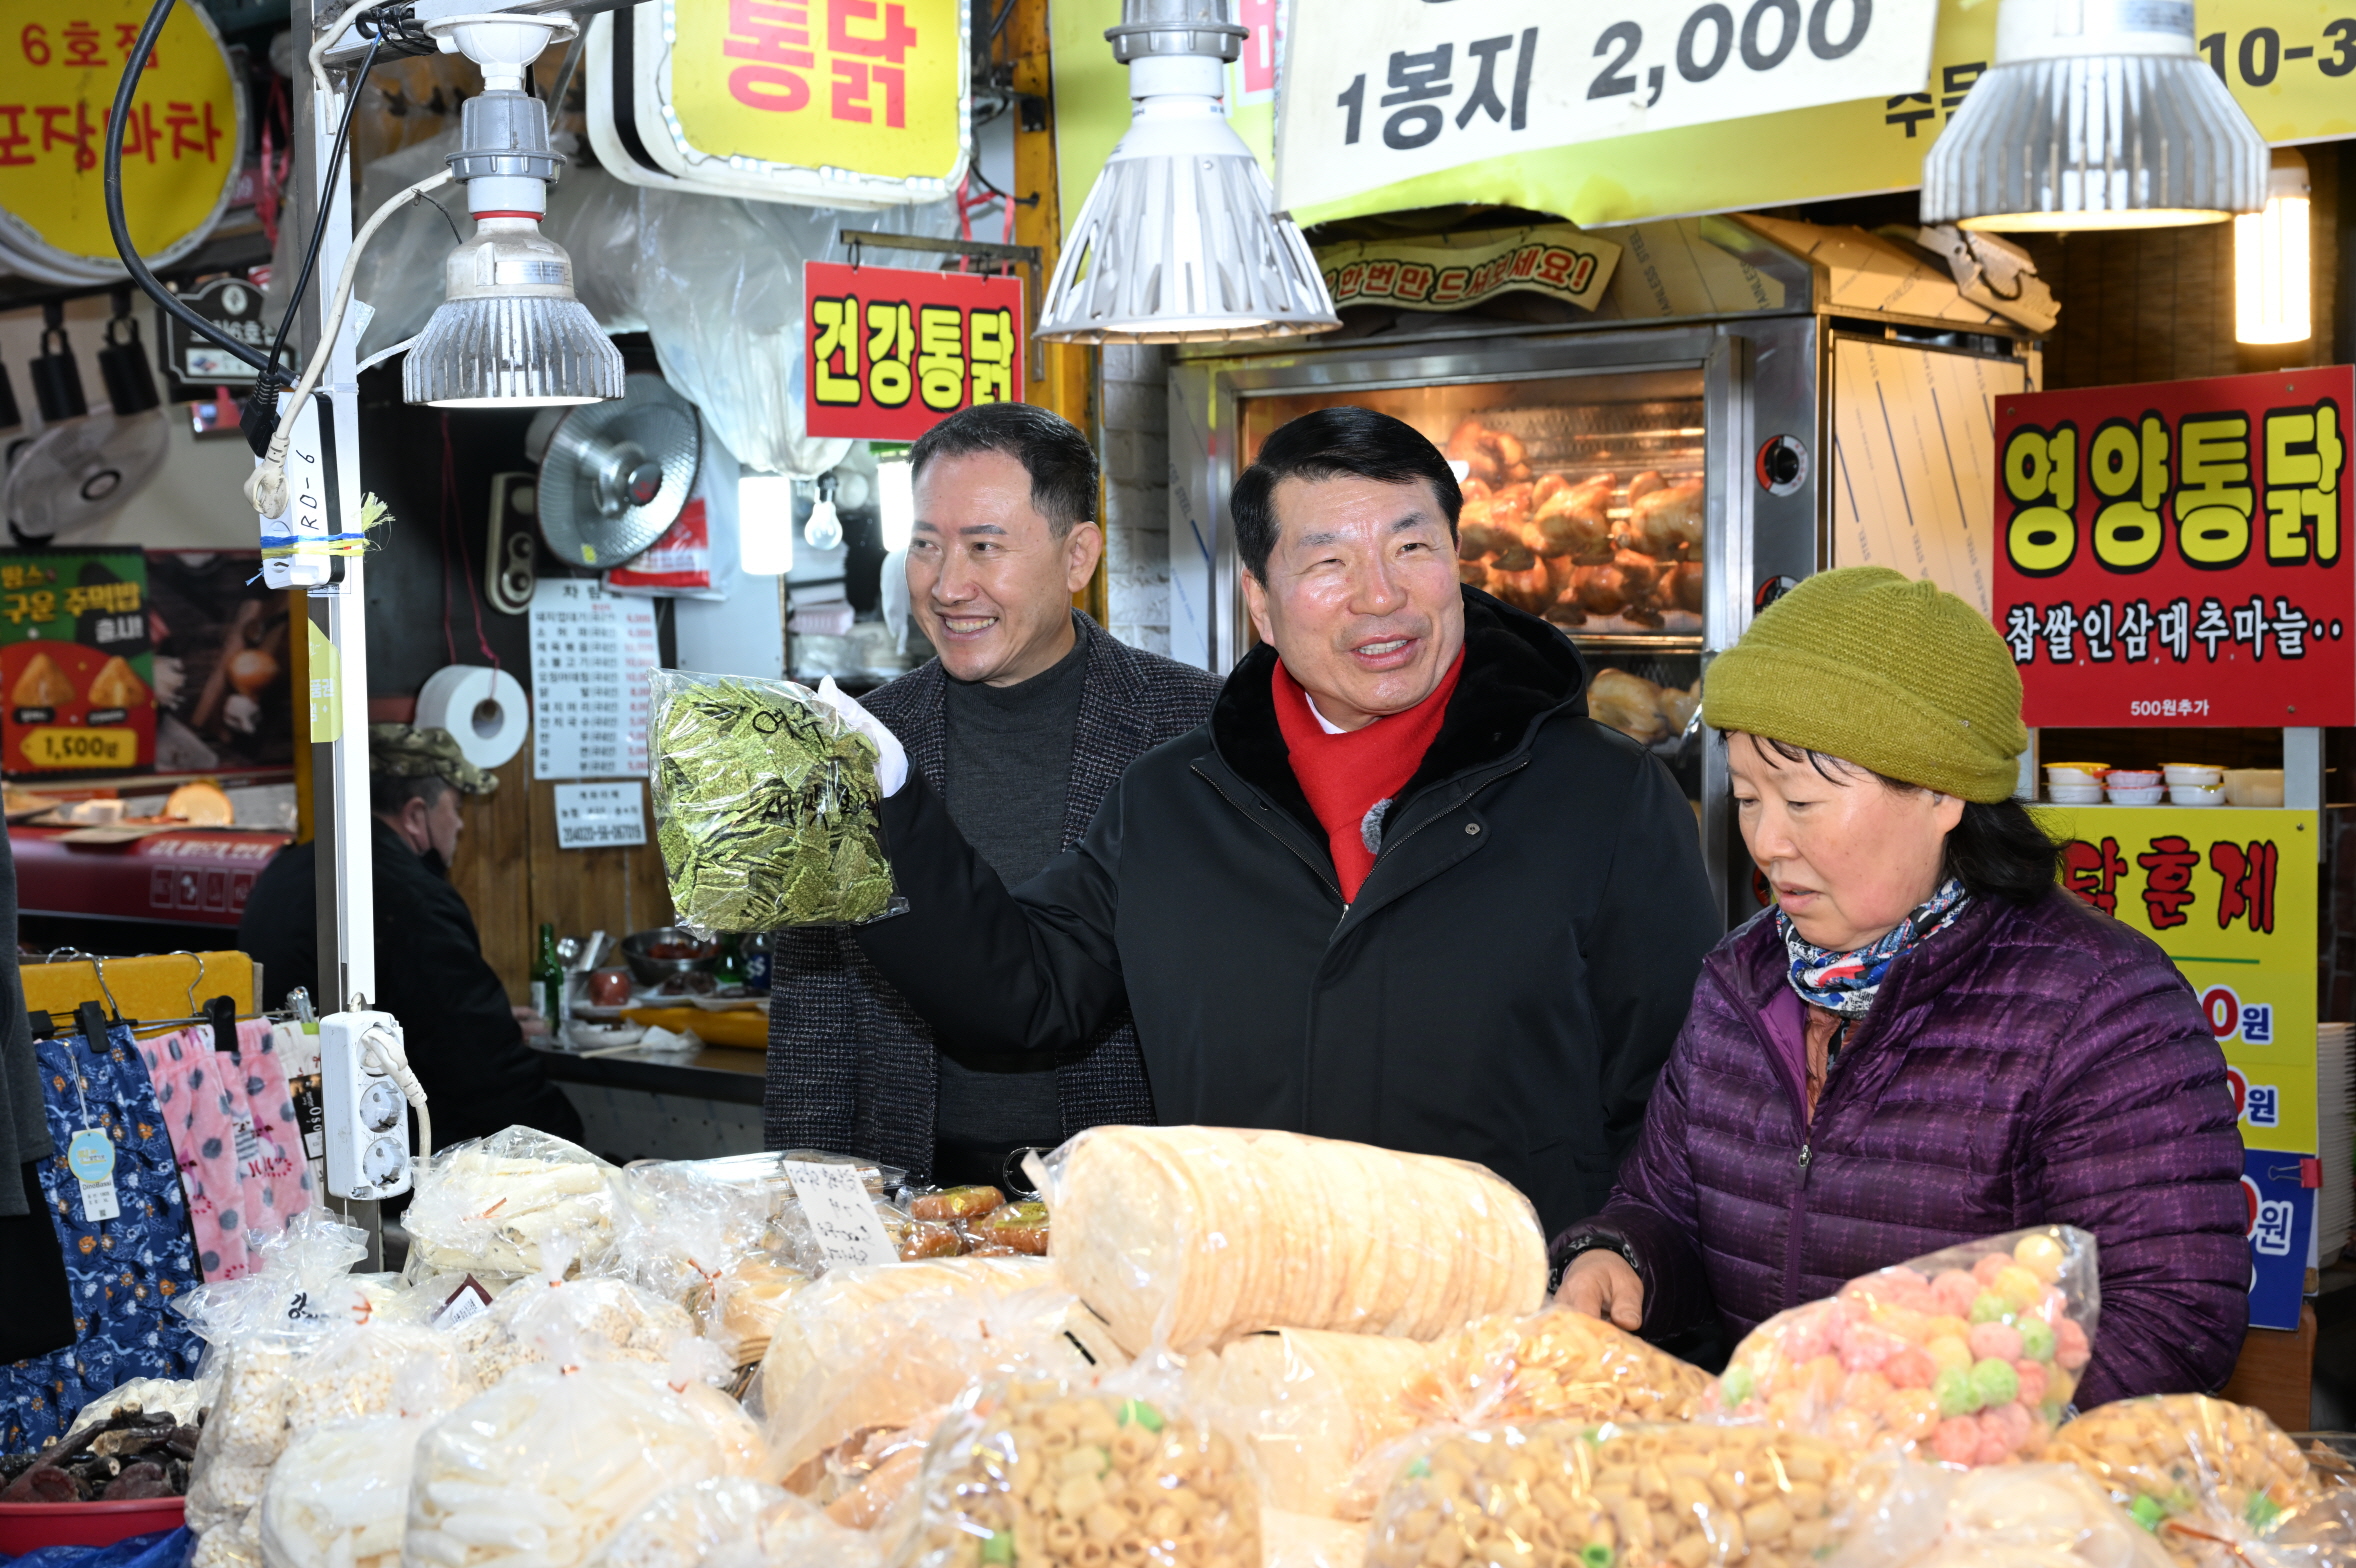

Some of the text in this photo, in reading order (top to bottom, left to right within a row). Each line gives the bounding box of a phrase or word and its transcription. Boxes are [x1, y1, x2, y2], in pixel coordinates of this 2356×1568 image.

[1337, 0, 1873, 150] 1봉지 2,000
[812, 294, 1016, 411] 건강통닭
[2000, 397, 2347, 579] 영양통닭
